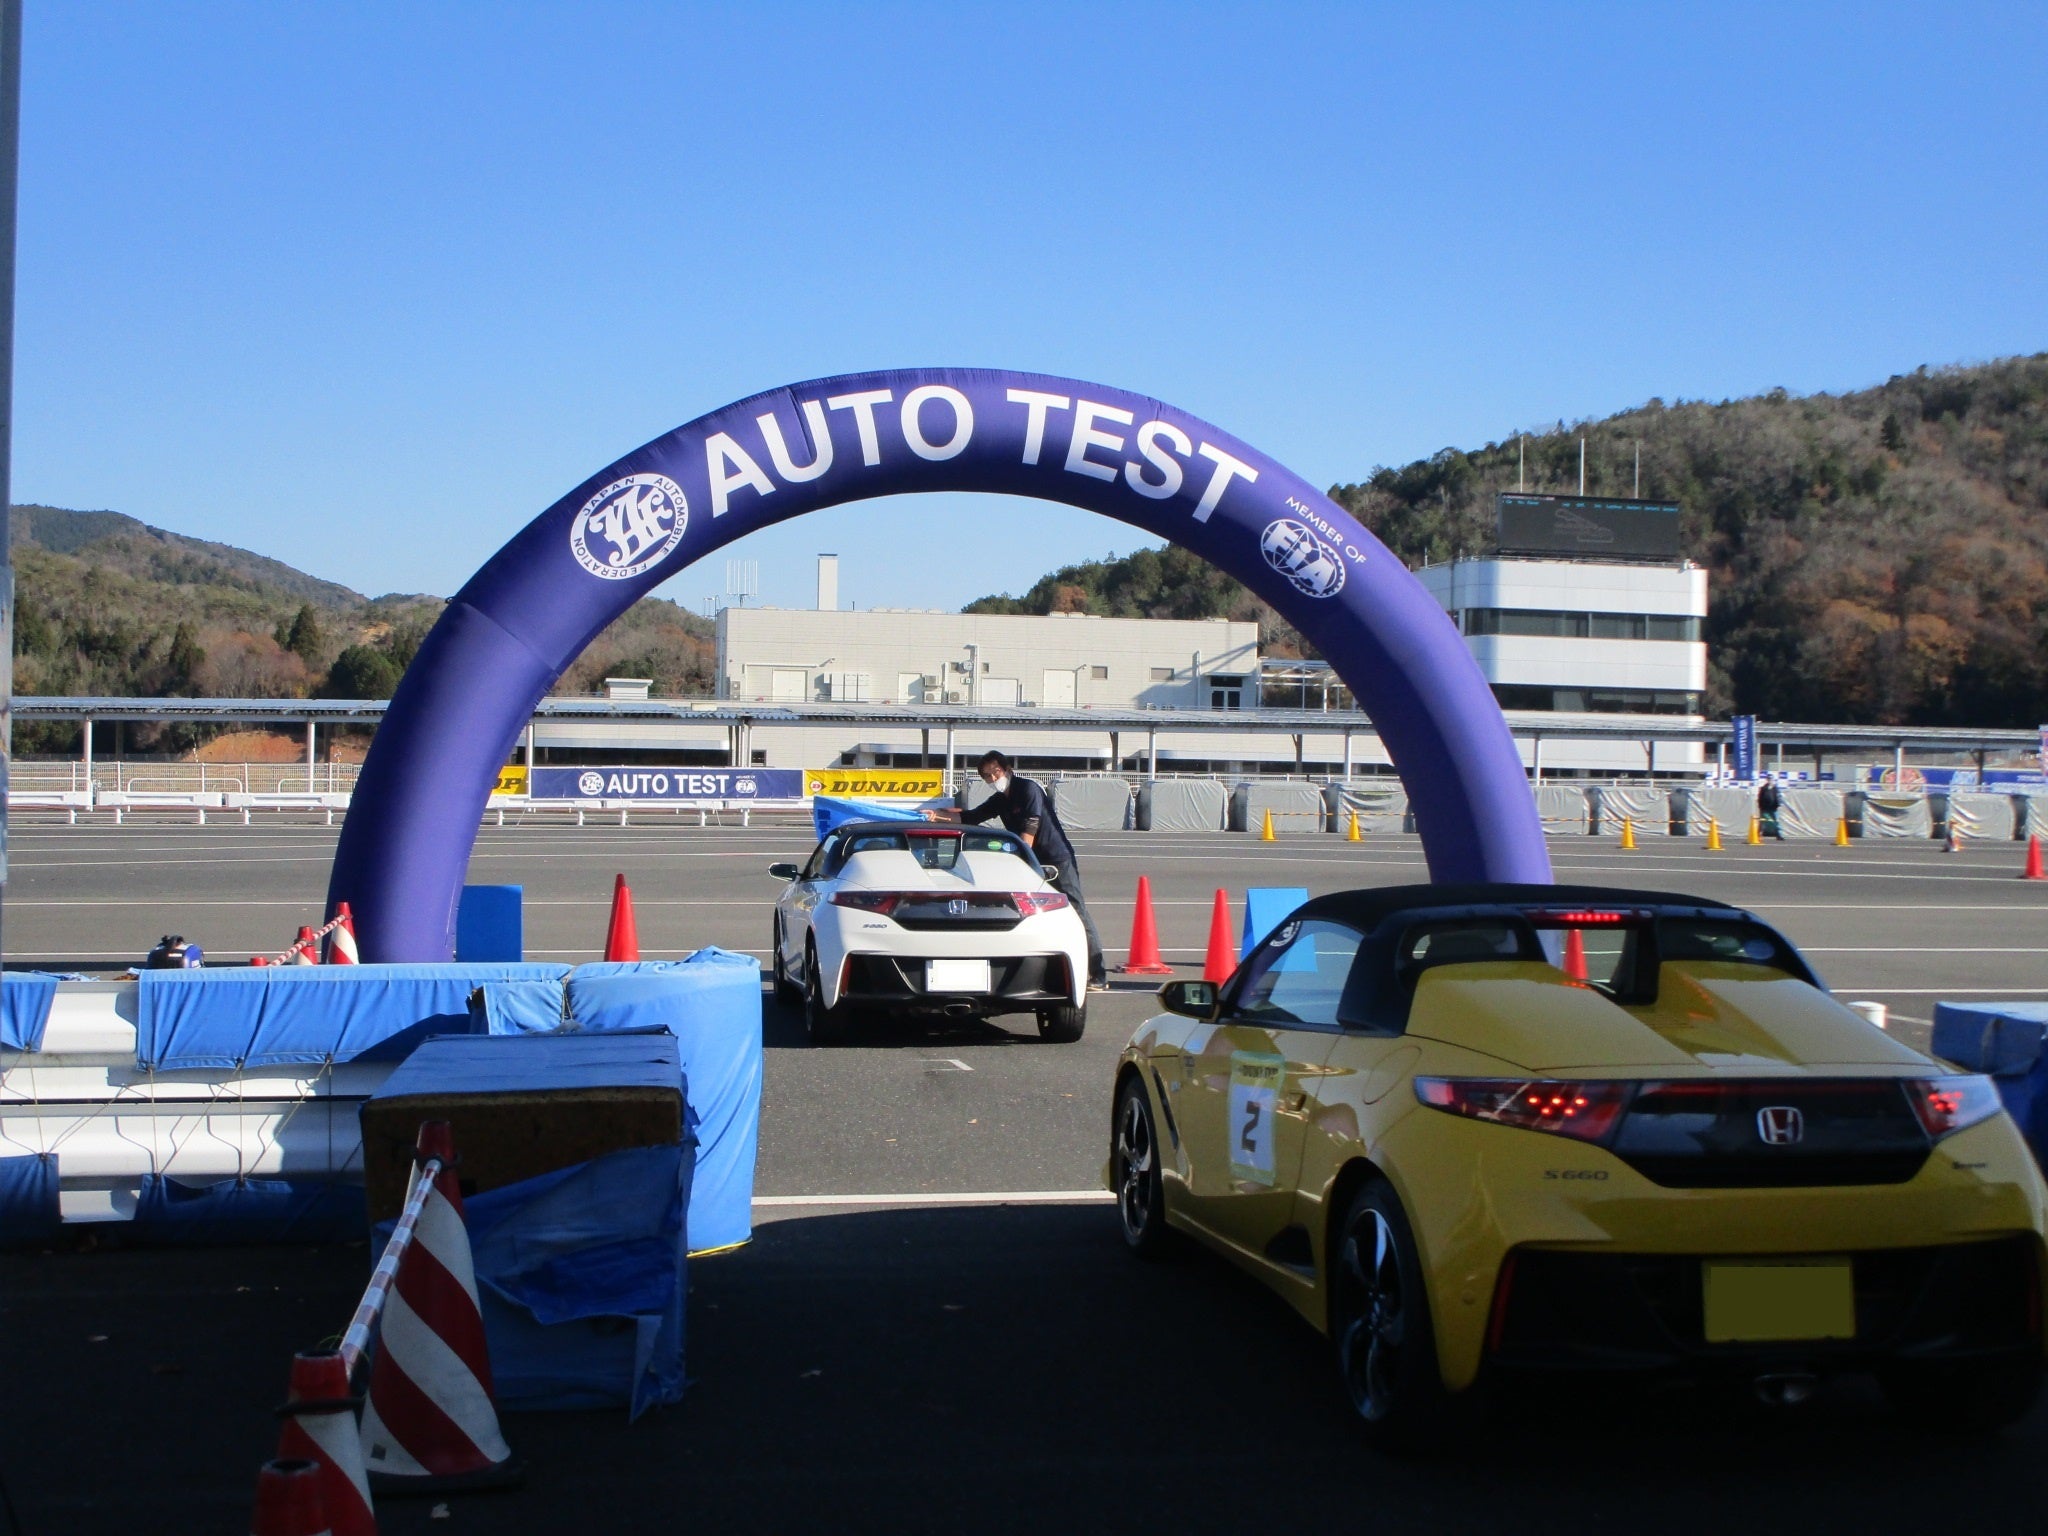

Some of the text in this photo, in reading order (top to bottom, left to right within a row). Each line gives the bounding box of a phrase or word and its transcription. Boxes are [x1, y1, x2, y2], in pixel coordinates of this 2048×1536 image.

[705, 385, 1259, 524] AUTO TEST
[574, 477, 686, 578] JAPAN AUTOMOBILE FEDERATION
[1285, 496, 1367, 564] MEMBER OF
[606, 773, 669, 794] AUTO
[674, 774, 729, 794] TEST
[830, 781, 938, 793] DUNLOP
[1242, 1100, 1260, 1152] 2
[1543, 1169, 1609, 1181] S660
